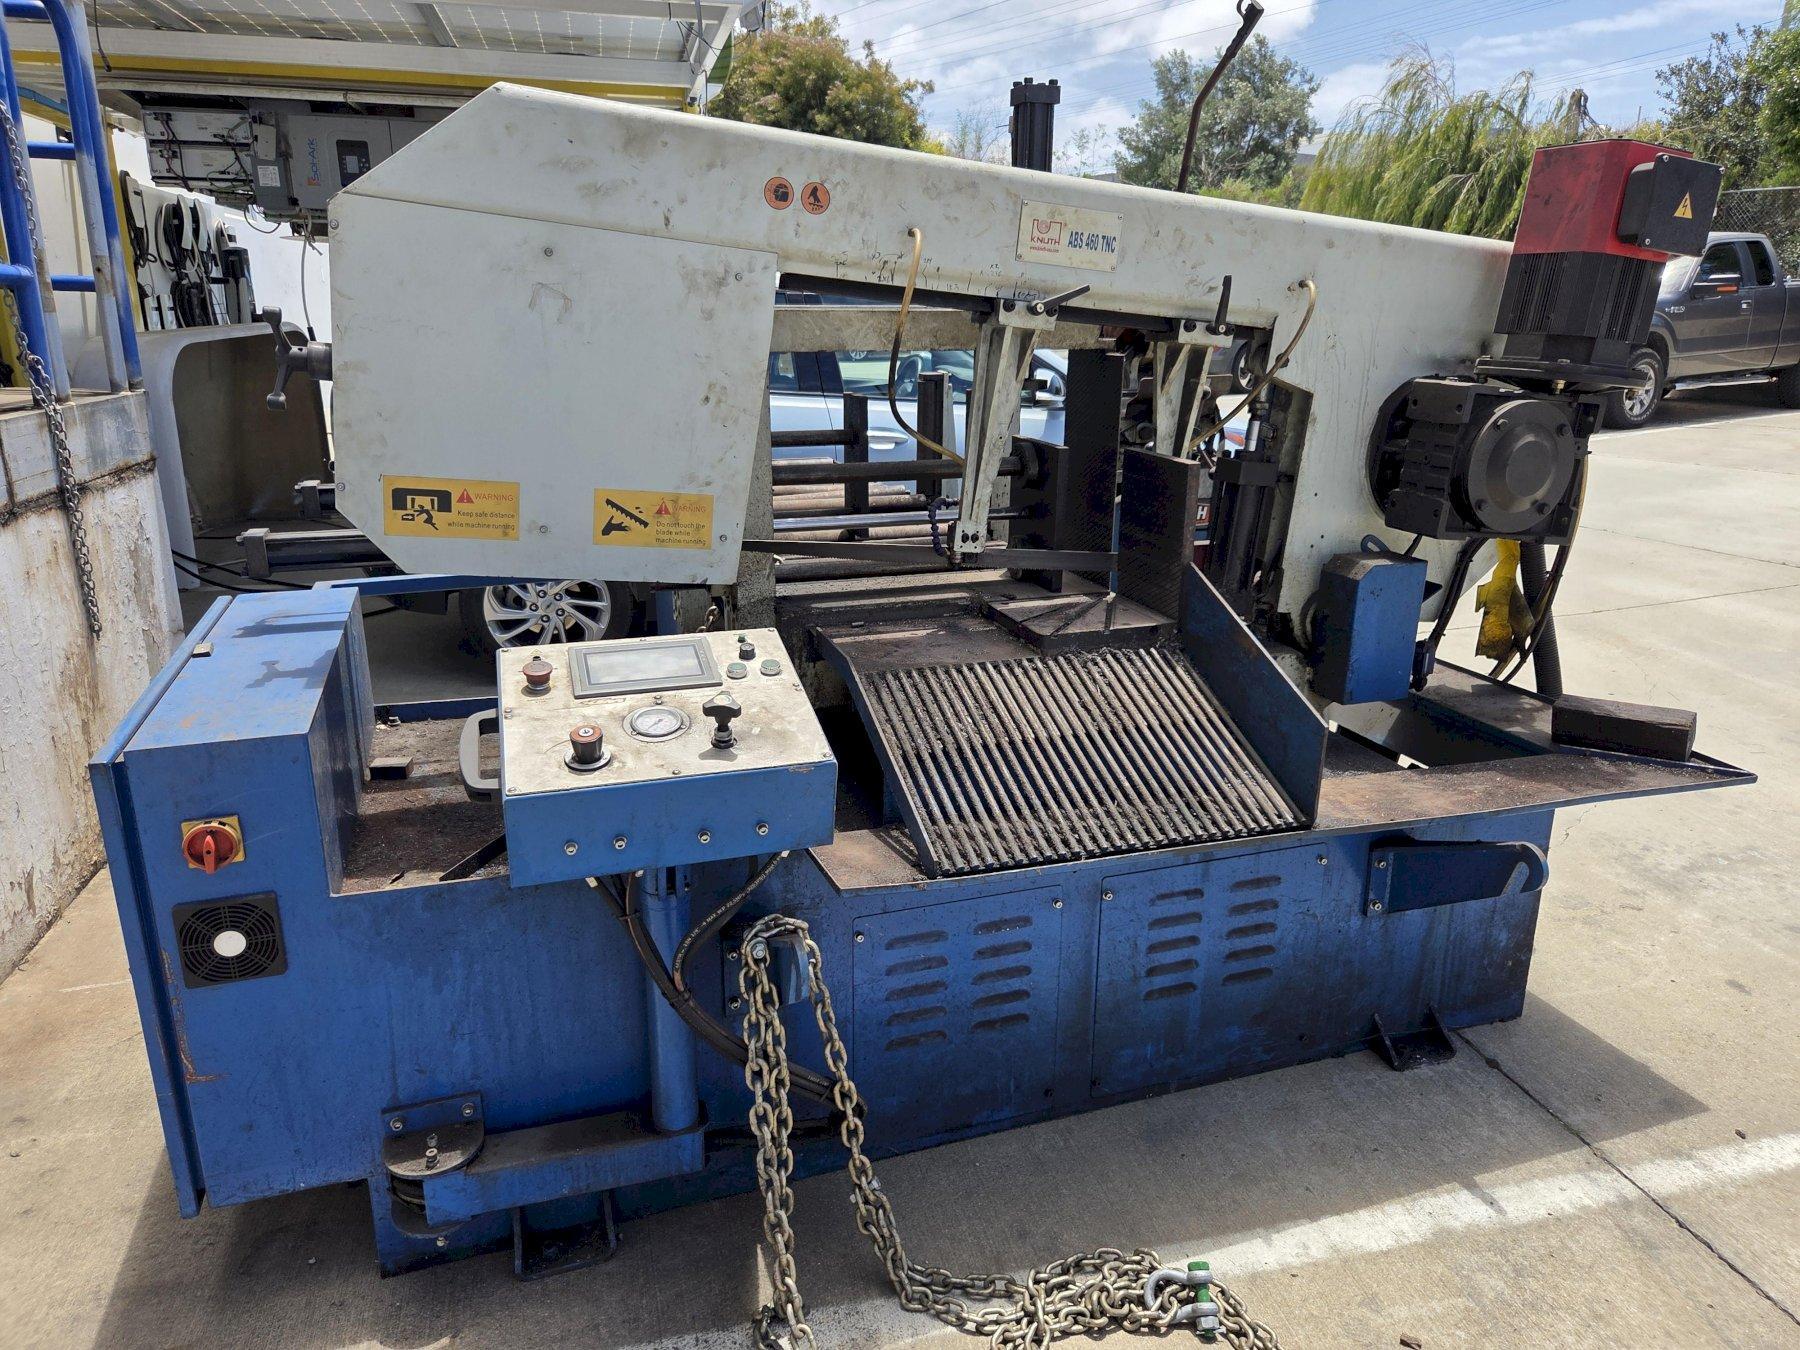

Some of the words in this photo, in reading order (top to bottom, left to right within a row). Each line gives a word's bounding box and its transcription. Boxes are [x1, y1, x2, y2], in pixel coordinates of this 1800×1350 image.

[1030, 236, 1060, 246] KNUTH
[1067, 231, 1084, 249] ABS
[1085, 232, 1099, 252] 460
[1101, 235, 1117, 254] TNC
[474, 493, 514, 502] WARNING
[673, 503, 706, 513] WARNING
[457, 510, 473, 518] Keep
